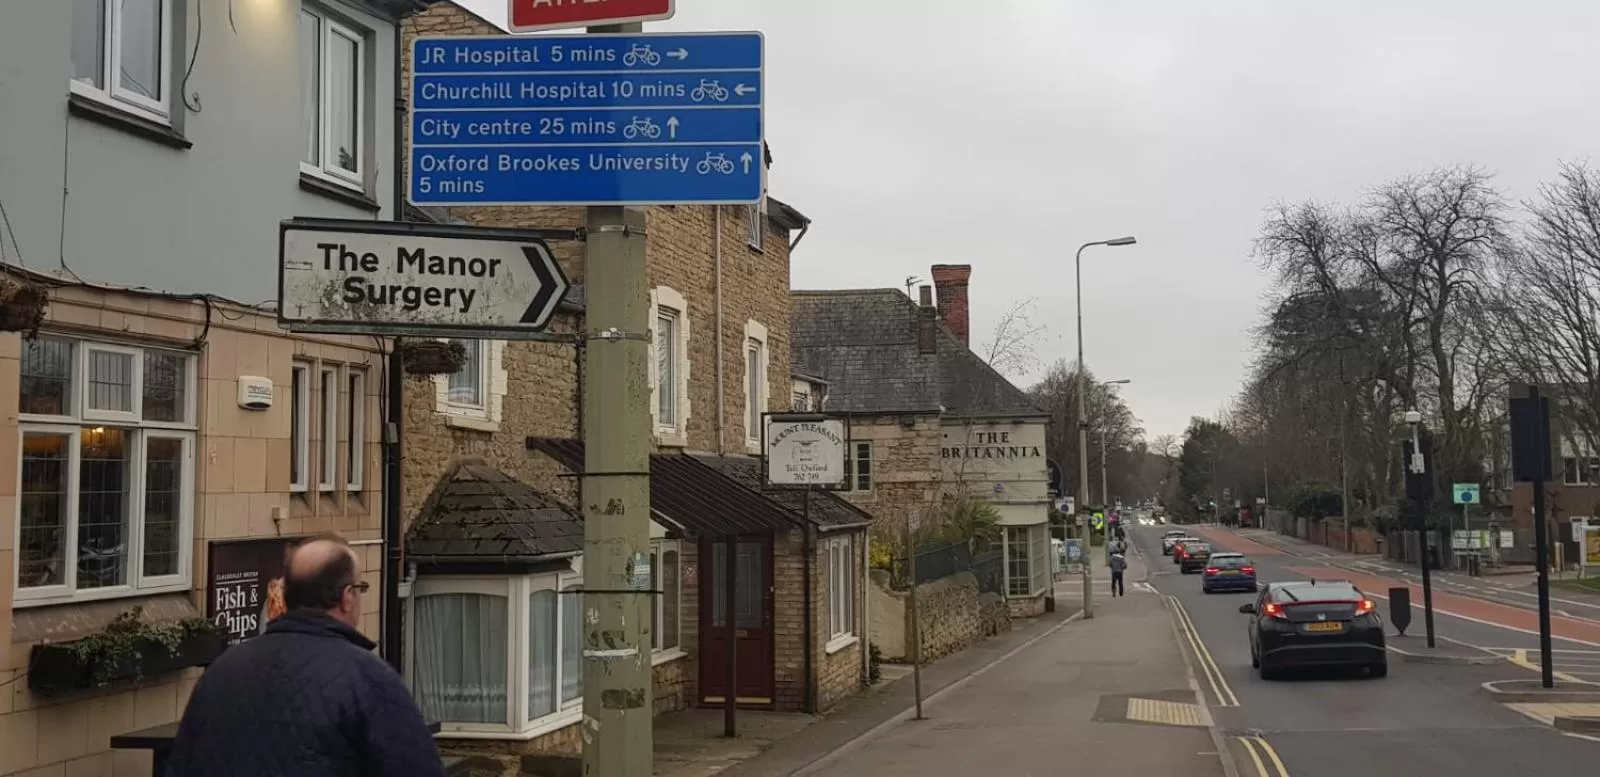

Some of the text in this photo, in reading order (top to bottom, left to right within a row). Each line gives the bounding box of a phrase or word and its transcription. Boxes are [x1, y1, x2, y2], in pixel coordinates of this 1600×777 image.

[421, 45, 616, 66] JR Hospital 5 mins
[421, 80, 685, 101] Churchill Hospital 10 mins
[421, 117, 616, 139] City centre 25 mins
[420, 153, 690, 173] Oxford Brookes University
[419, 177, 485, 193] 5 mins
[317, 243, 502, 278] The Manor
[342, 276, 476, 313] Surgery
[770, 423, 843, 448] MOUNT PLEASANT
[976, 431, 1010, 444] THE
[942, 445, 1041, 459] BRITANNIA
[800, 463, 828, 472] Oxford
[215, 585, 258, 611] Fish &
[214, 610, 257, 638] Chips
